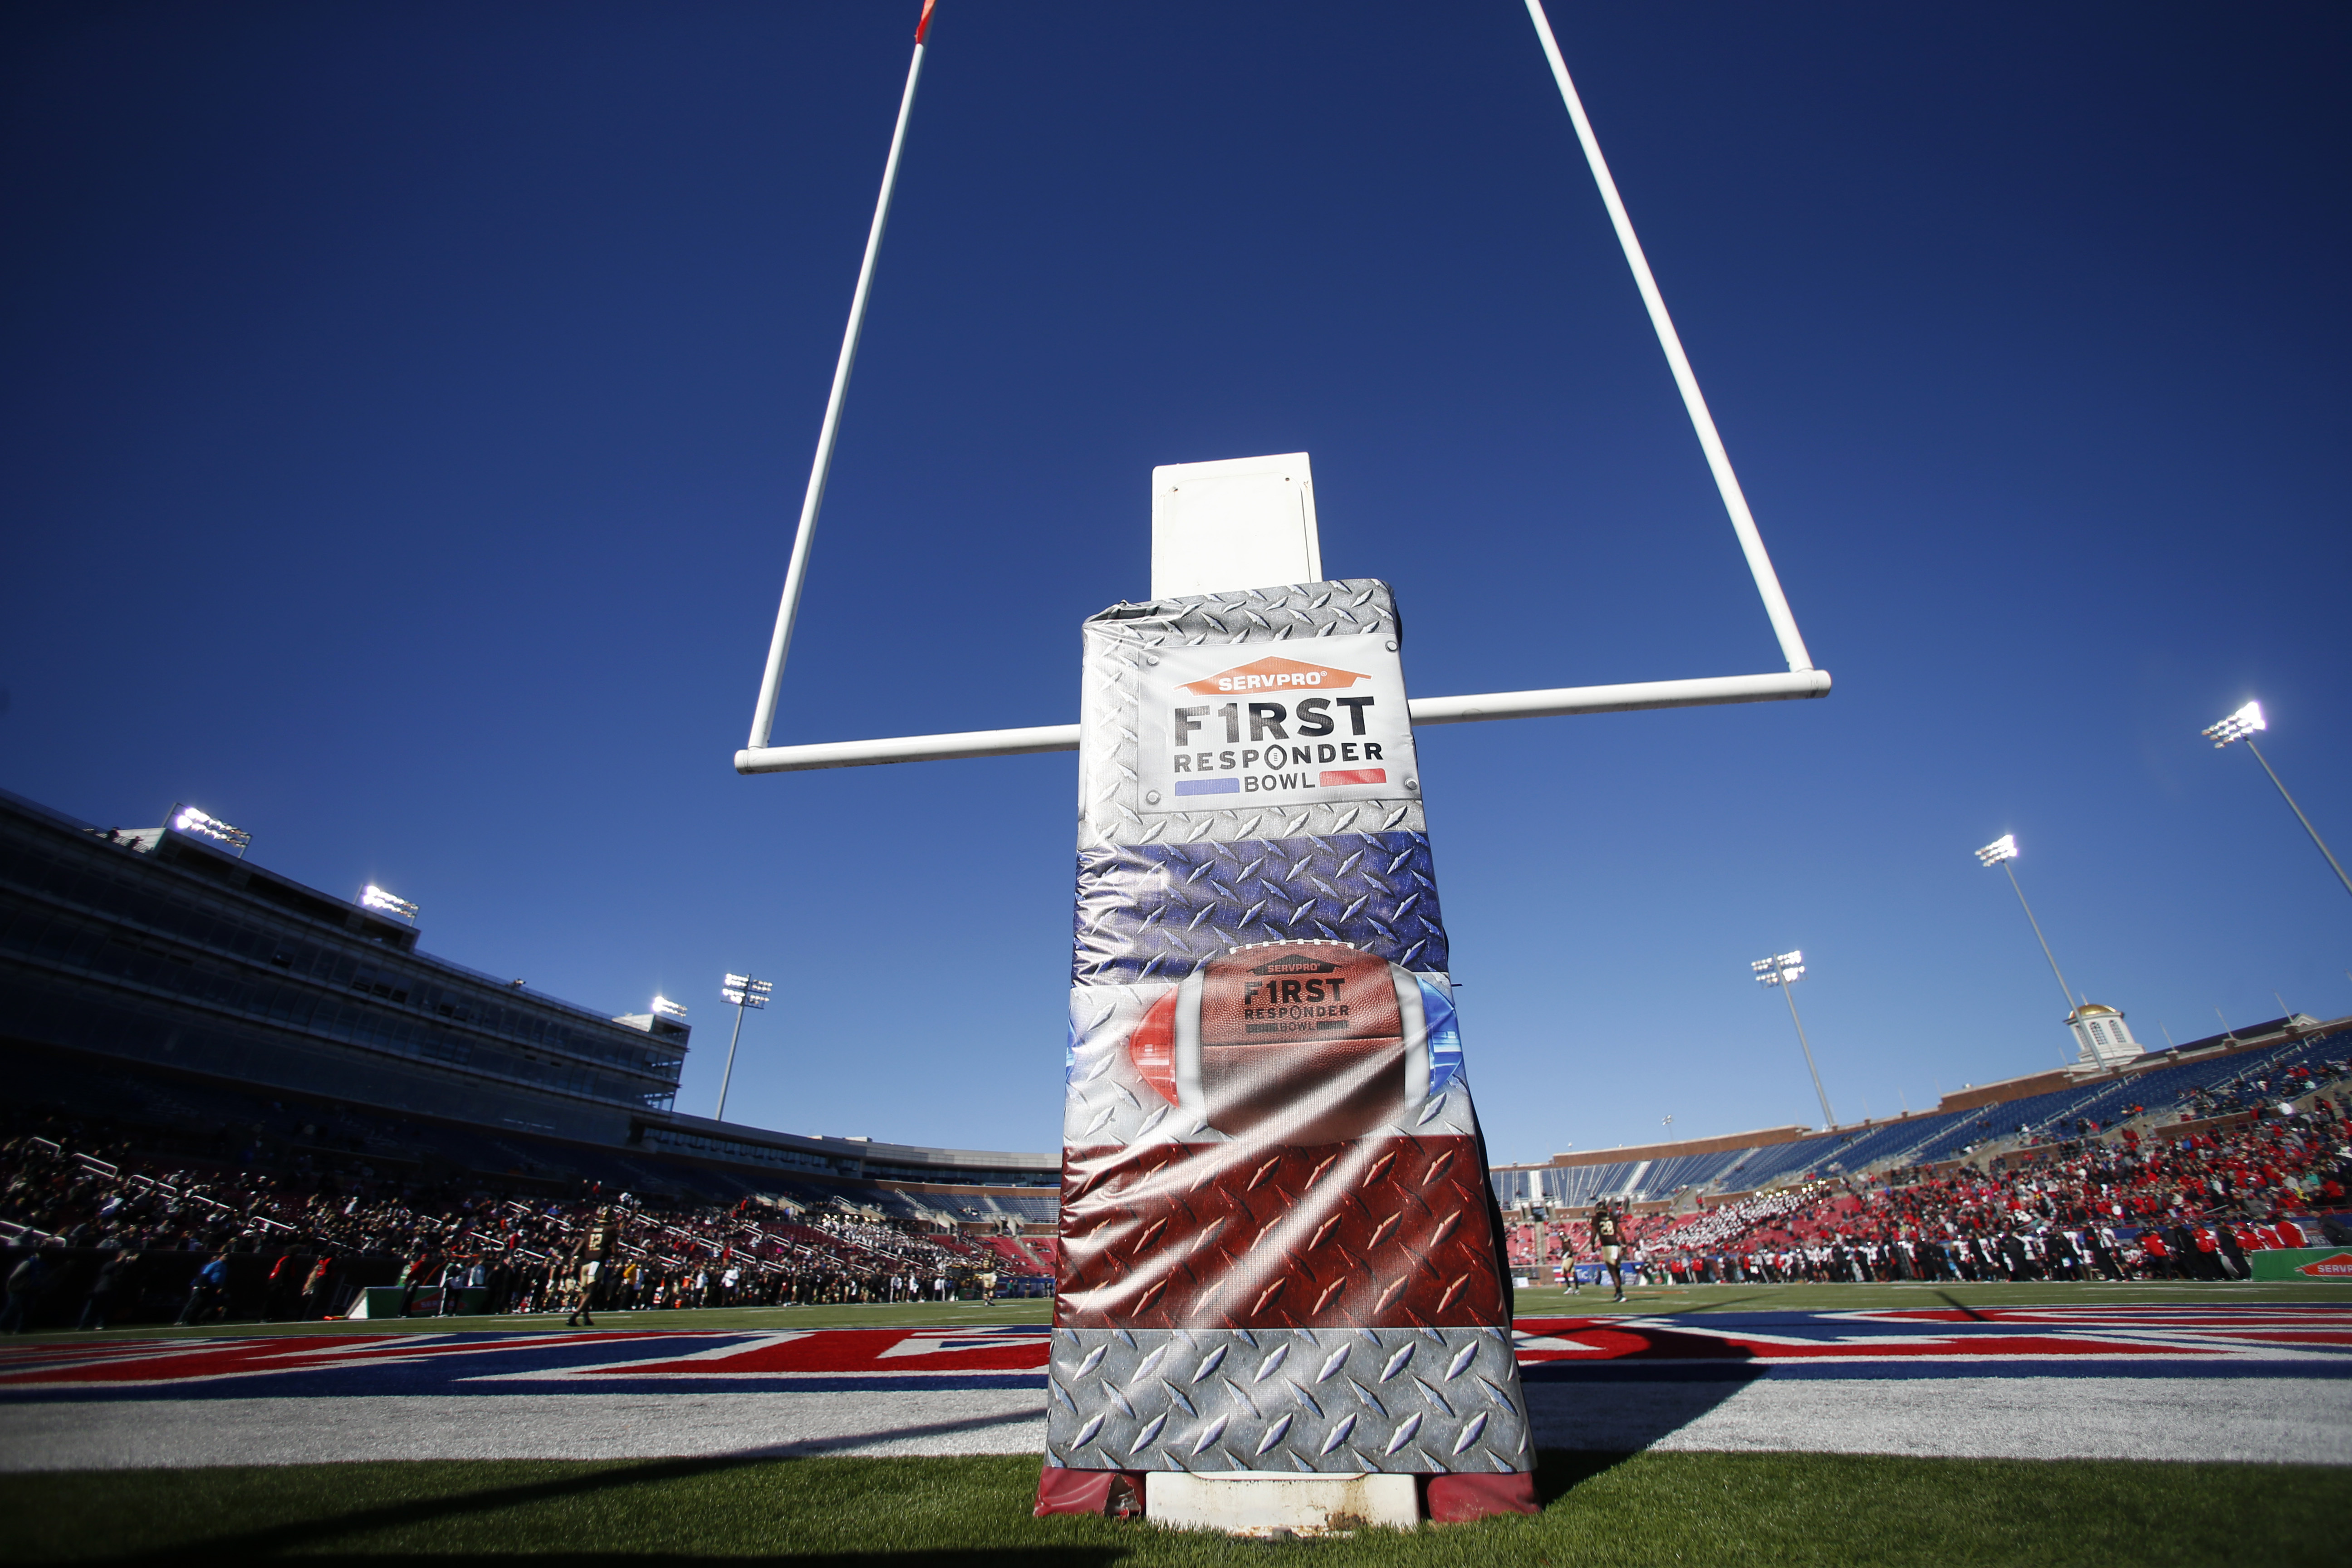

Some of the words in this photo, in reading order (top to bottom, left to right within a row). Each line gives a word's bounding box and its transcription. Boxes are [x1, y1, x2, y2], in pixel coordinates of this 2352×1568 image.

[1174, 696, 1375, 747] F1RST
[1174, 743, 1384, 773] RESPONDER
[1244, 772, 1315, 793] BOWL
[1245, 978, 1345, 1005] F1RST
[1245, 1004, 1349, 1020] RESPONDER
[1280, 1021, 1315, 1032] BOWL
